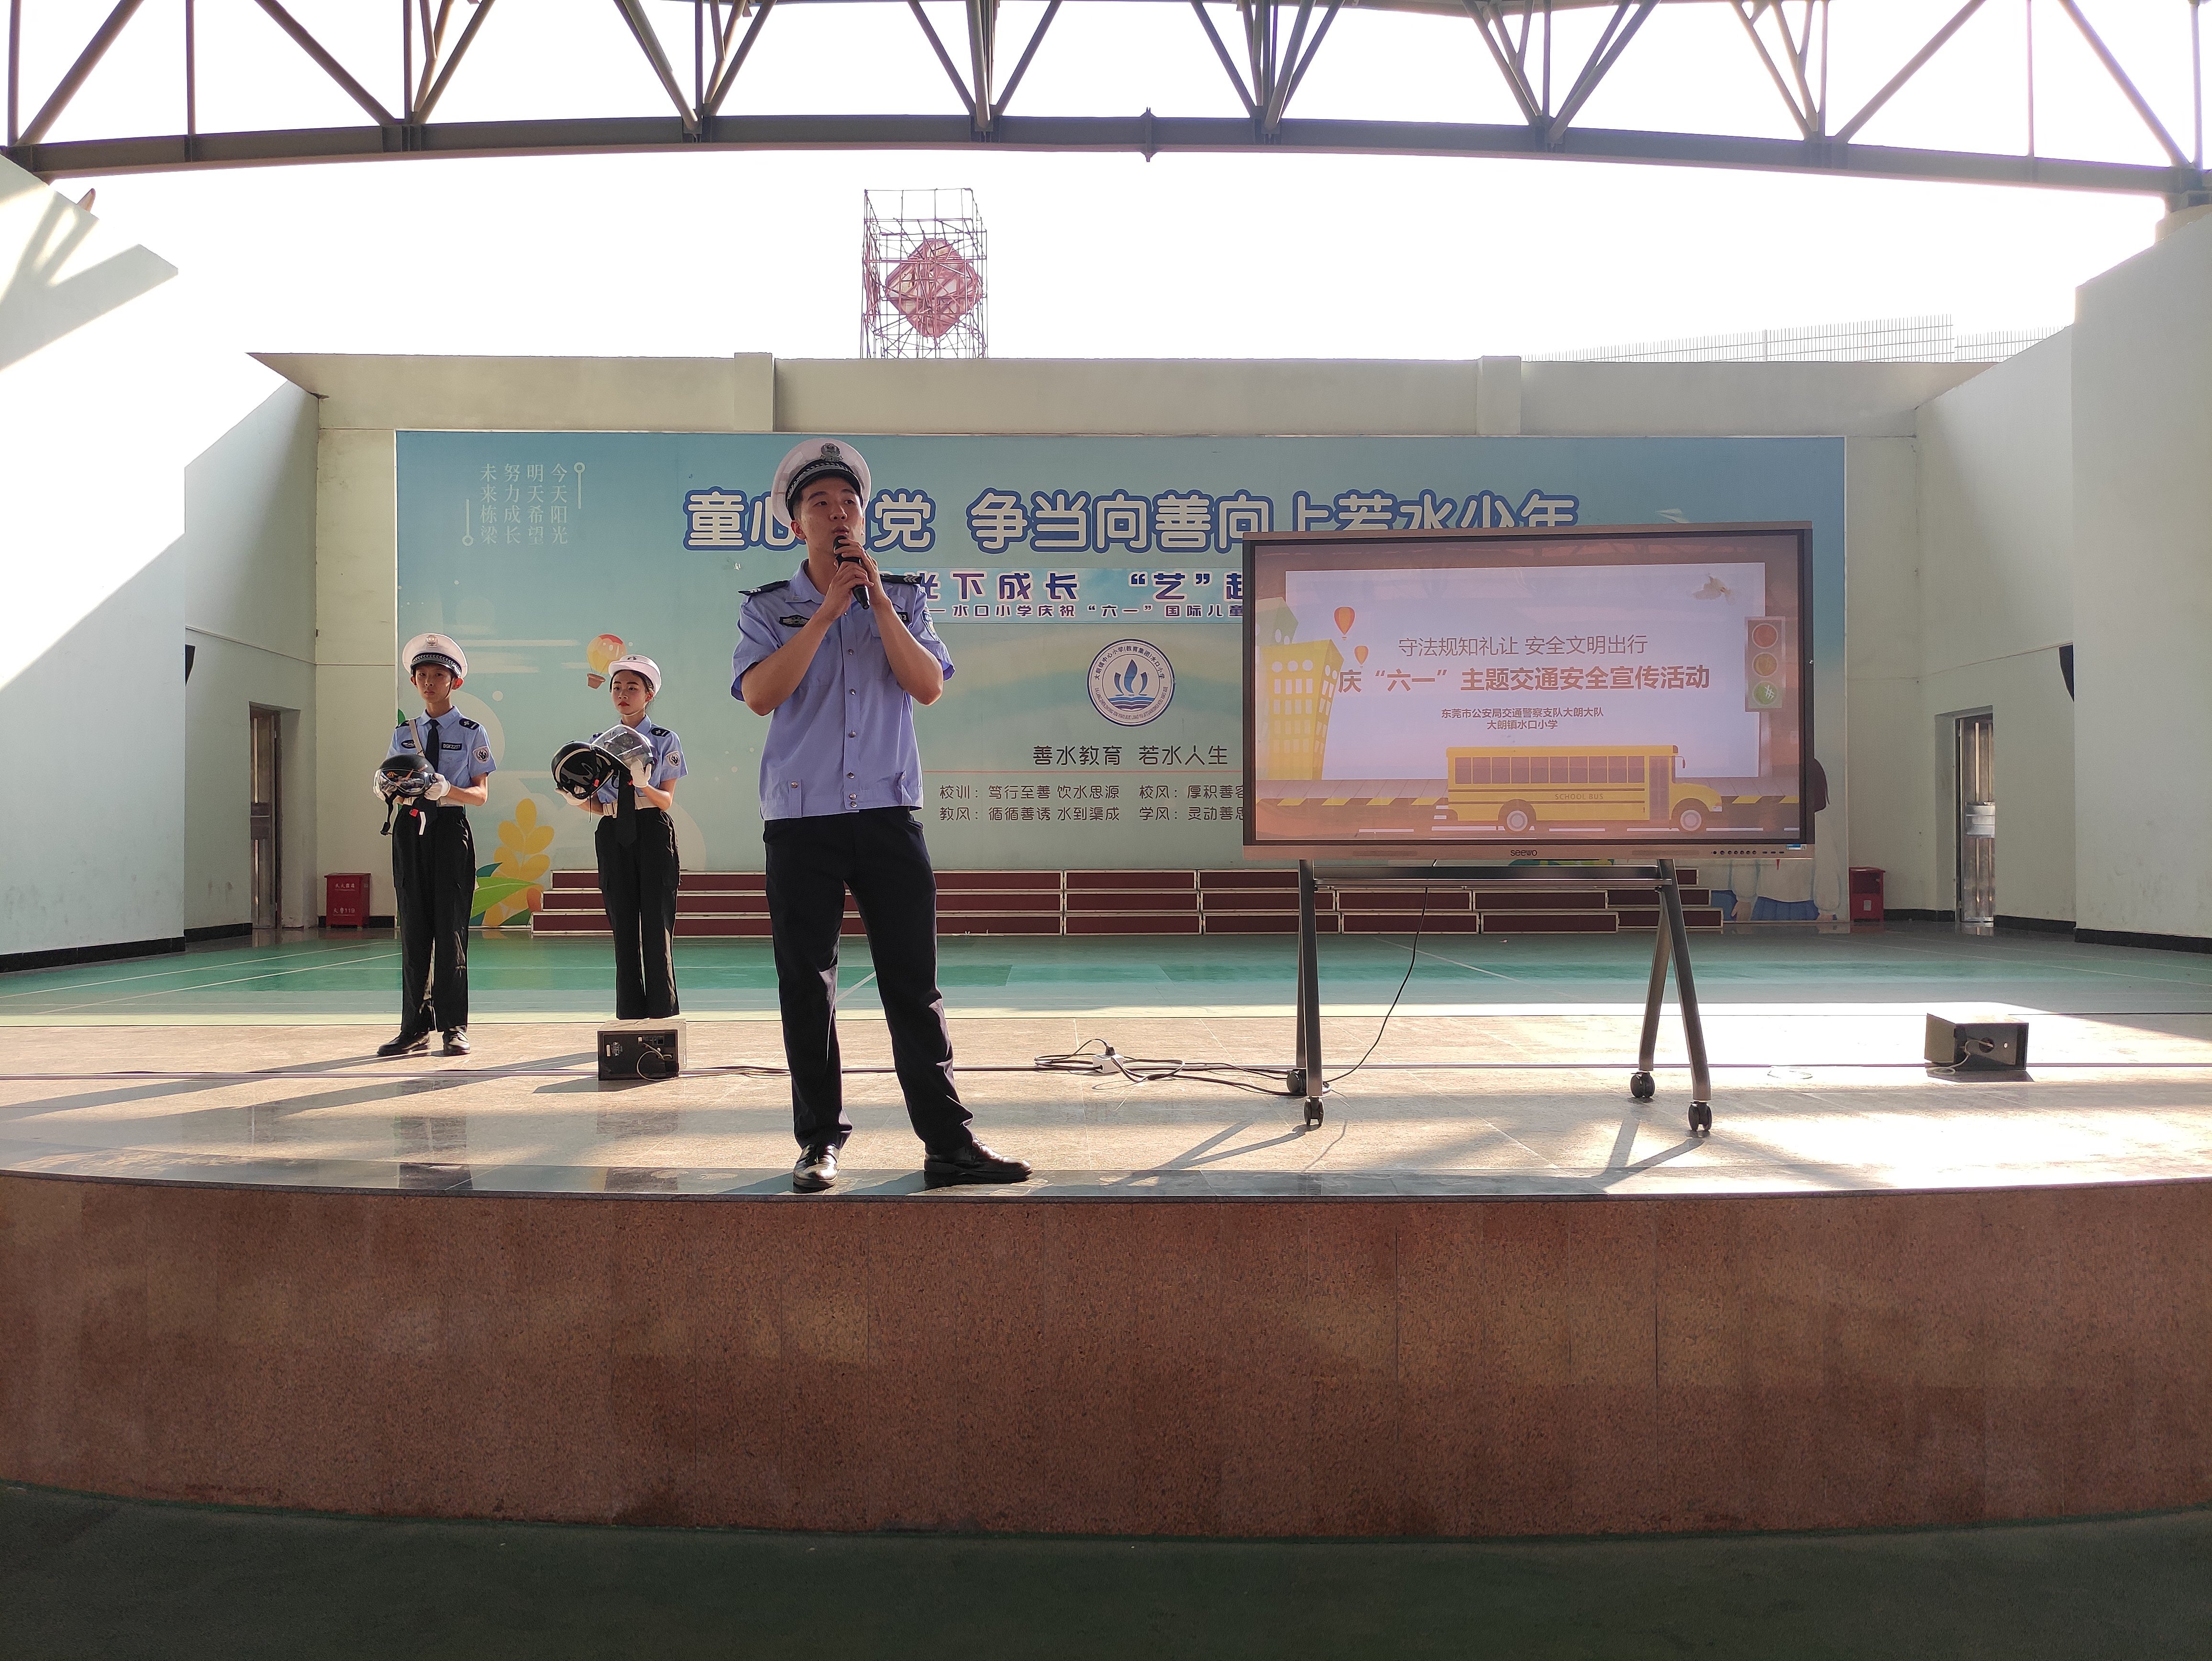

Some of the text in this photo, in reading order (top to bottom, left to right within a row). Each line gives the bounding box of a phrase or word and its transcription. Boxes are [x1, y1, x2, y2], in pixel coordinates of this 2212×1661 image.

[480, 464, 498, 544] 未来栋梁
[504, 464, 521, 544] 努力成长
[527, 464, 544, 544] 明天希望
[551, 464, 568, 544] 今天阳光
[684, 487, 1578, 554] 童心党 争当向善向上若水少年
[1398, 634, 1648, 657] 守法规知礼让 安全文明出行
[1441, 707, 1604, 719] 东莞市公安局交通警察支队大朗大队
[1487, 720, 1558, 730] 大朗镇水口小学
[1033, 744, 1229, 765] 善水教育 若水人生
[1057, 785, 1119, 799] 饮水思源
[1057, 807, 1119, 821] 水到渠成
